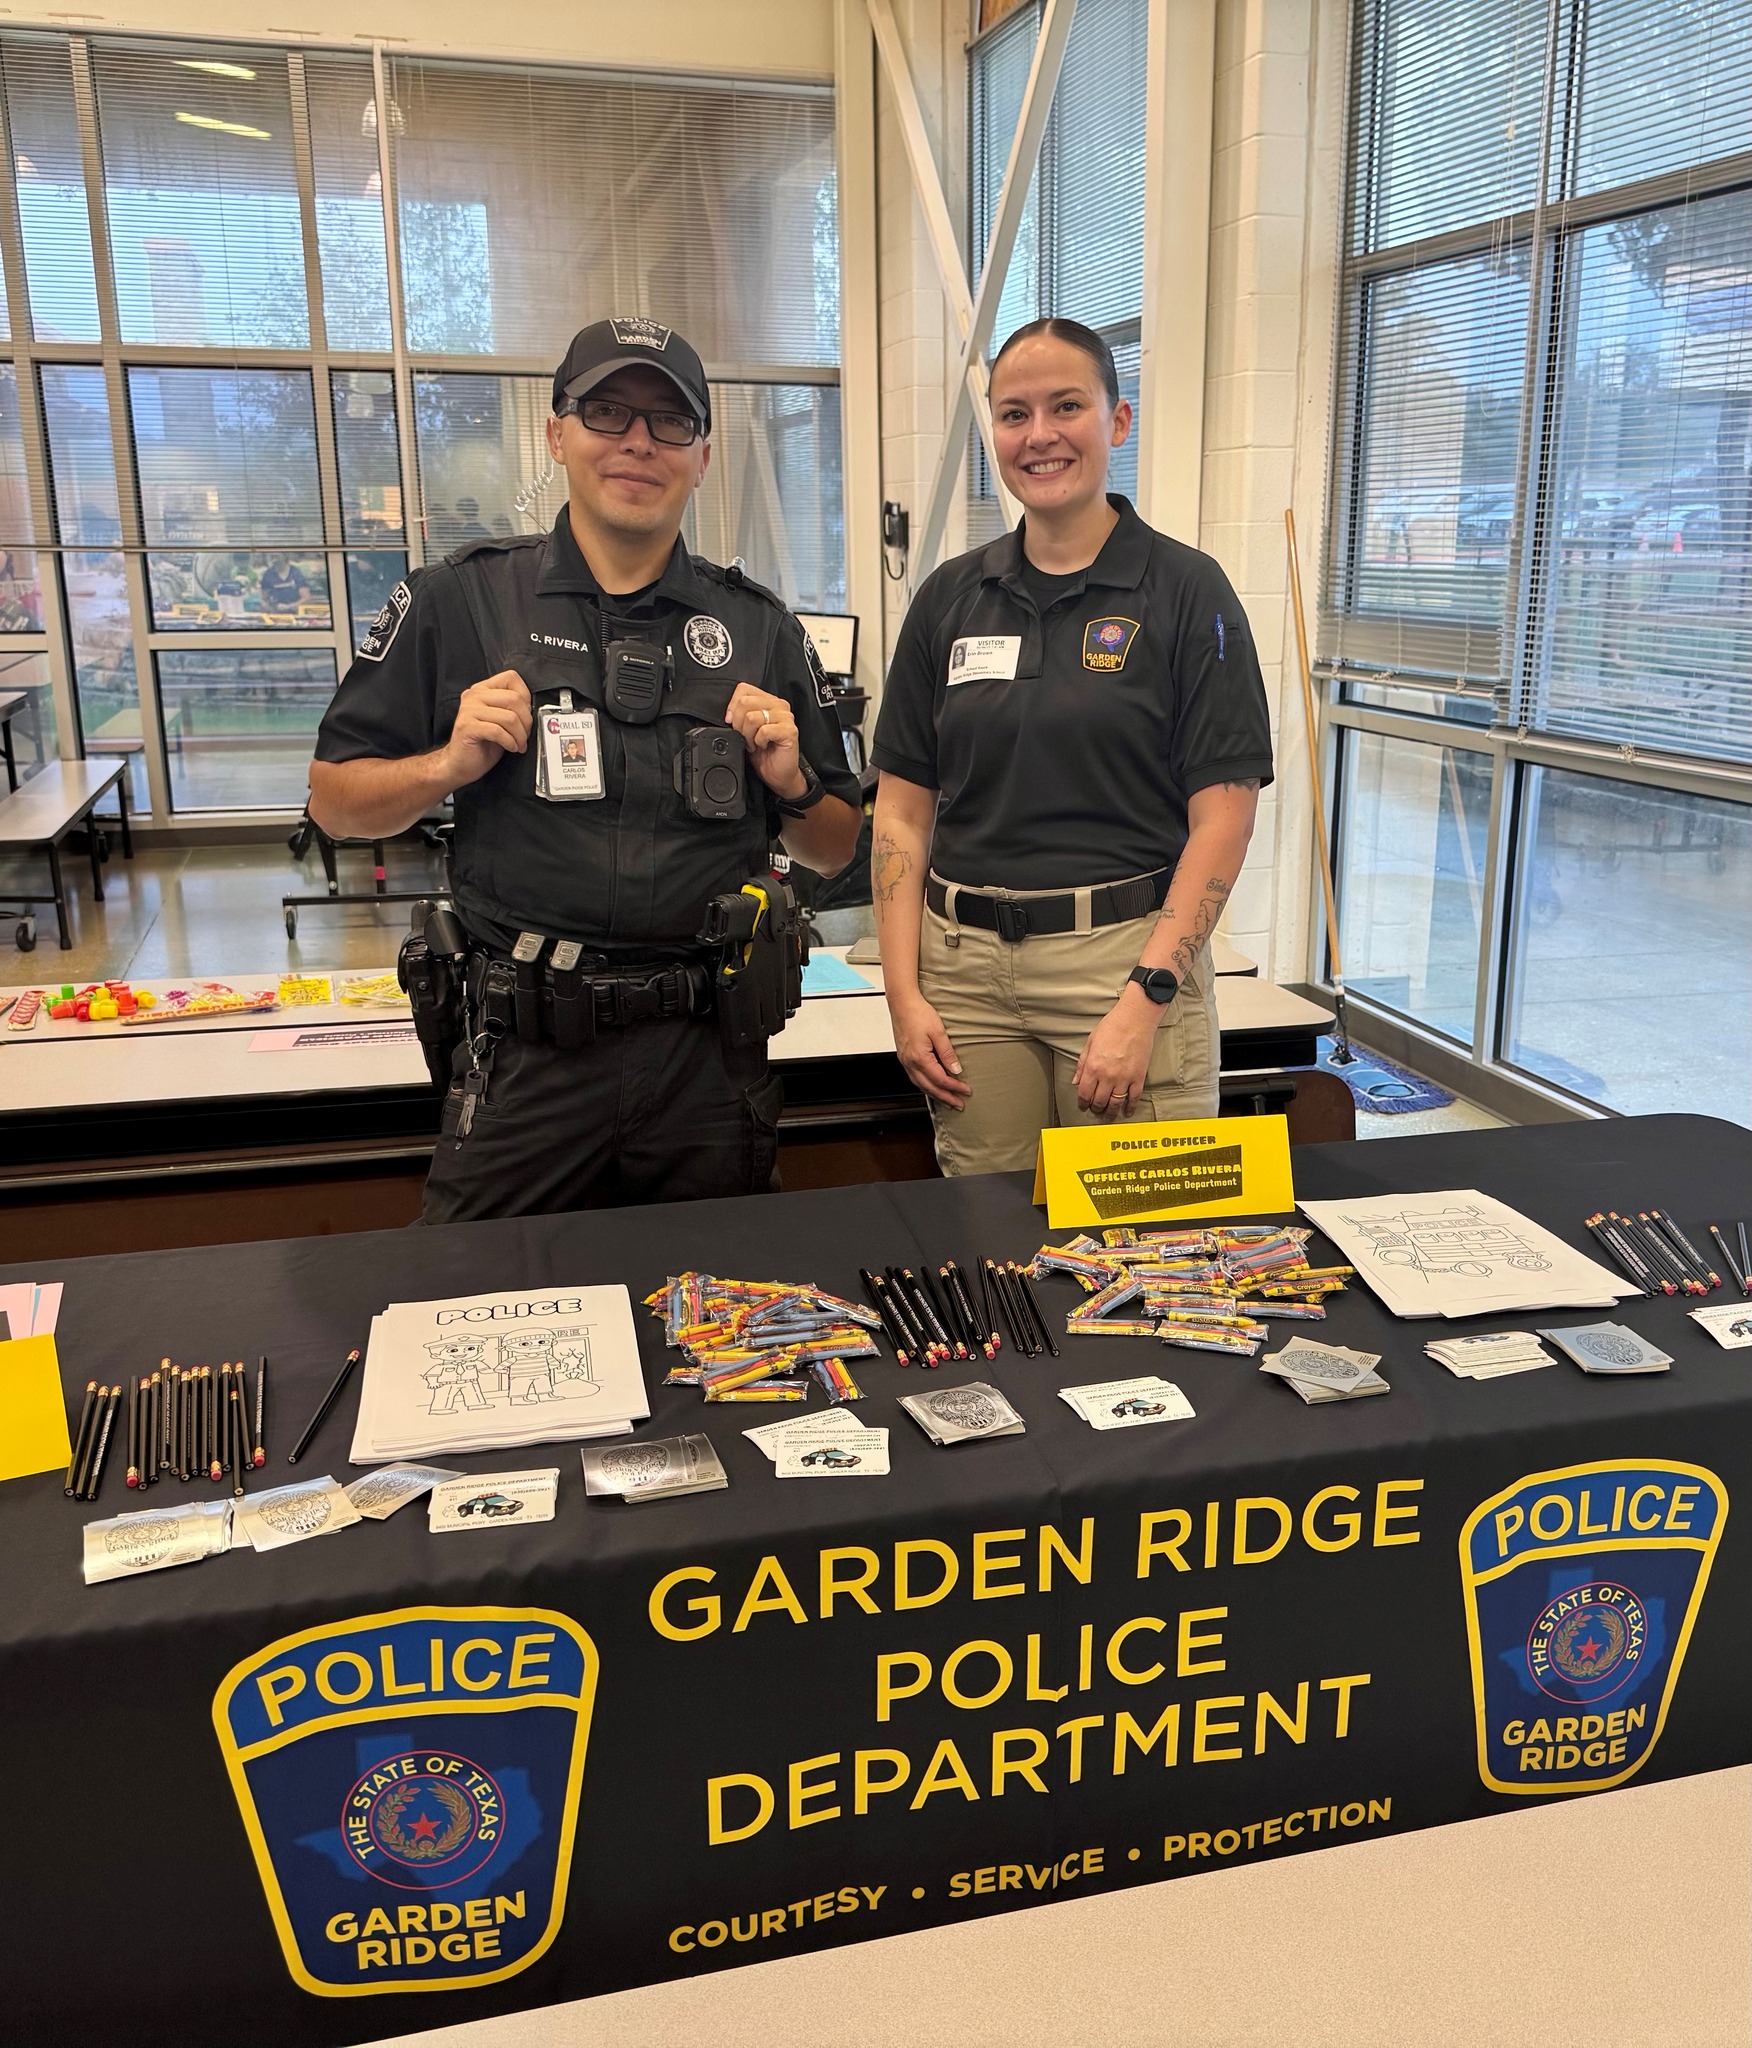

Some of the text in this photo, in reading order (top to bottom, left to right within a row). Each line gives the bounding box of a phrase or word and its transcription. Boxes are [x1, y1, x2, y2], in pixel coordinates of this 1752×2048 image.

[530, 633, 589, 652] C. RIVERA
[1086, 653, 1122, 662] GARDEN
[1089, 659, 1117, 668] RIDGE
[581, 721, 593, 729] ISD
[1110, 1135, 1216, 1151] POLICE OFFICER
[1083, 1163, 1242, 1183] OFFICER CARLOS RIVERA
[1090, 1177, 1237, 1196] Garden Ridge Police Department
[1411, 1218, 1482, 1230] POLICE
[436, 1298, 582, 1326] POLICE
[440, 1484, 466, 1492] GARDEN
[1495, 1485, 1701, 1557] POLICE
[648, 1479, 1425, 1642] GARDEN RIDGE
[1532, 1587, 1644, 1676] THE STATE OF TEXAS
[256, 1632, 556, 1727] POLICE
[876, 1606, 1228, 1723] POLICE
[1502, 1703, 1647, 1746] GARDEN
[706, 1673, 1372, 1847] DEPARTMENT
[1519, 1736, 1628, 1772] RIDGE
[349, 1757, 499, 1859] THE STATE OF TEXAS
[668, 1797, 1393, 1955] COURTESY SERVICE PROTECTION
[325, 1890, 527, 1943] GARDEN
[357, 1929, 502, 1970] RIDGE
